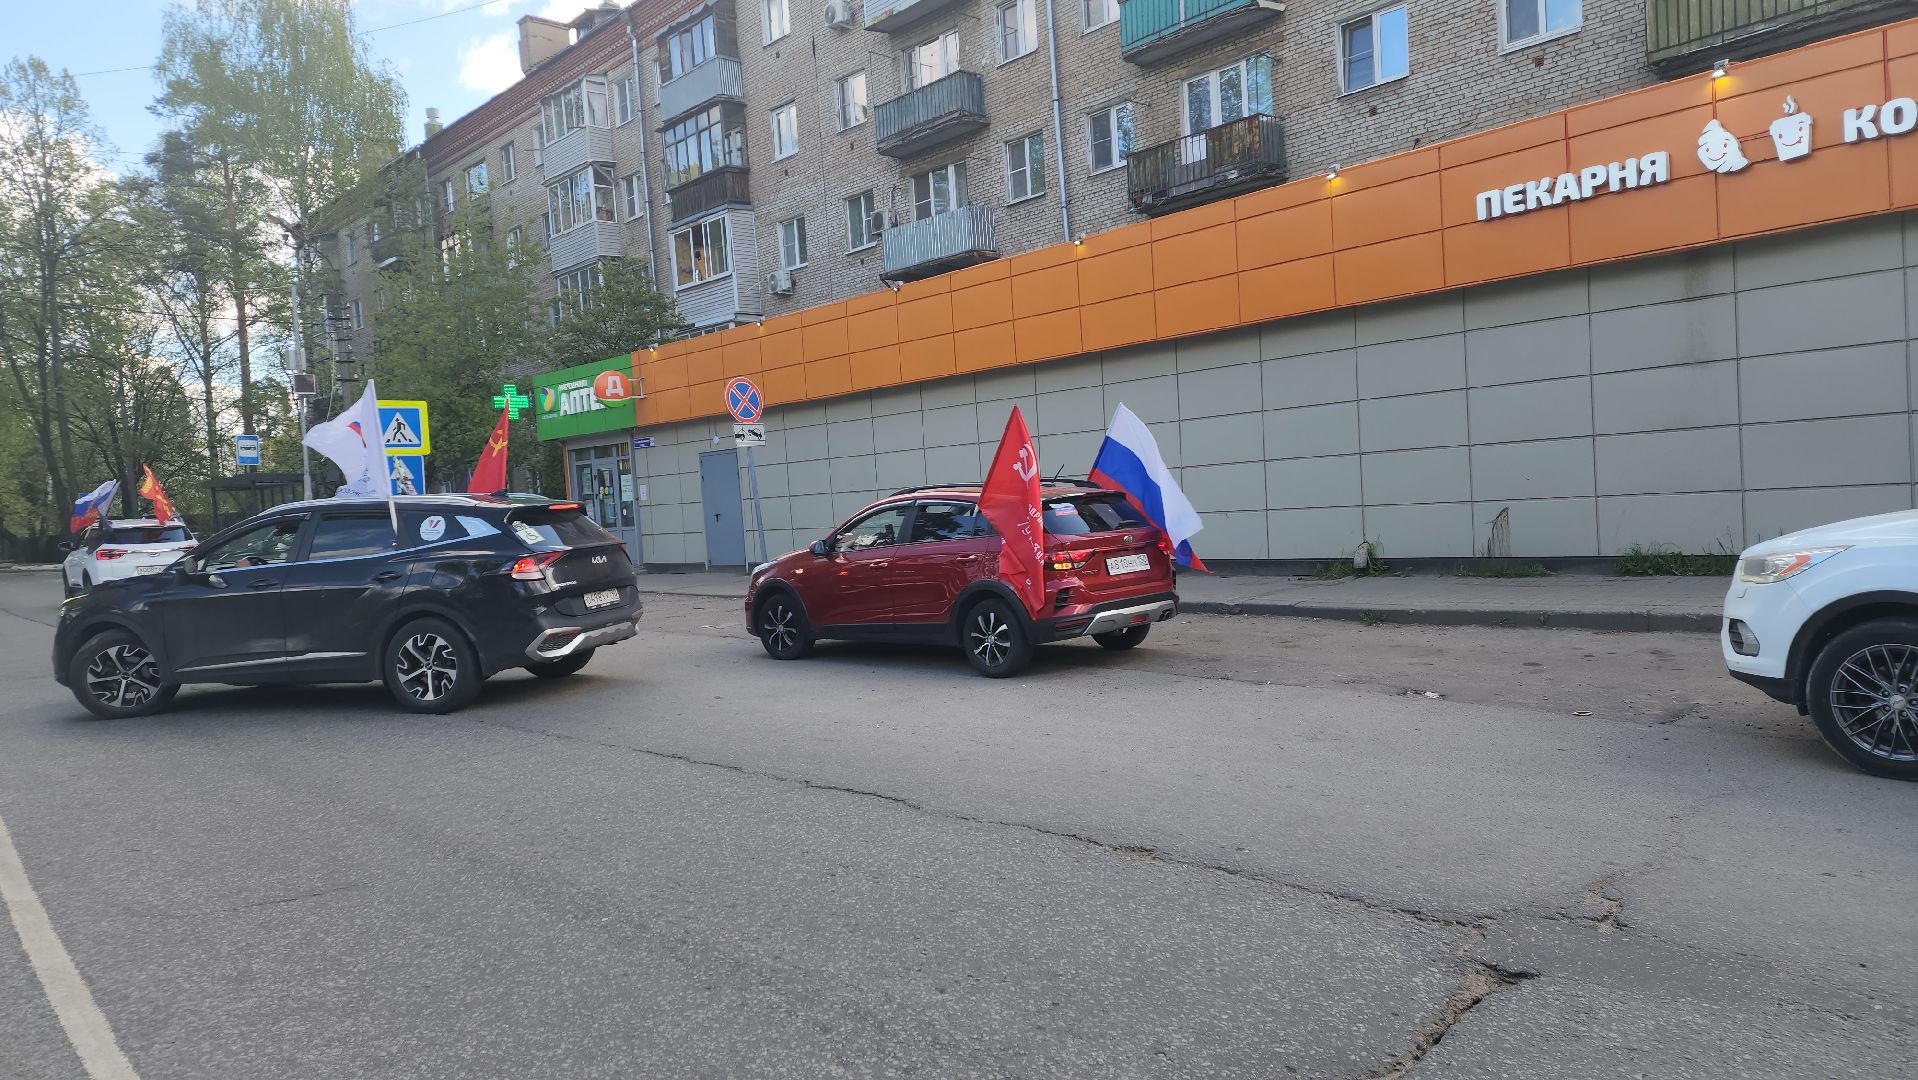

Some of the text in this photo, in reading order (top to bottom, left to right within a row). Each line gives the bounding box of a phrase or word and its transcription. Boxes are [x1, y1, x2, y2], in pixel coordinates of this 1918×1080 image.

[1843, 96, 1918, 143] КО
[1475, 150, 1671, 221] ПЕКАРНЯ
[559, 386, 606, 417] АПТЕ
[605, 375, 624, 397] Д
